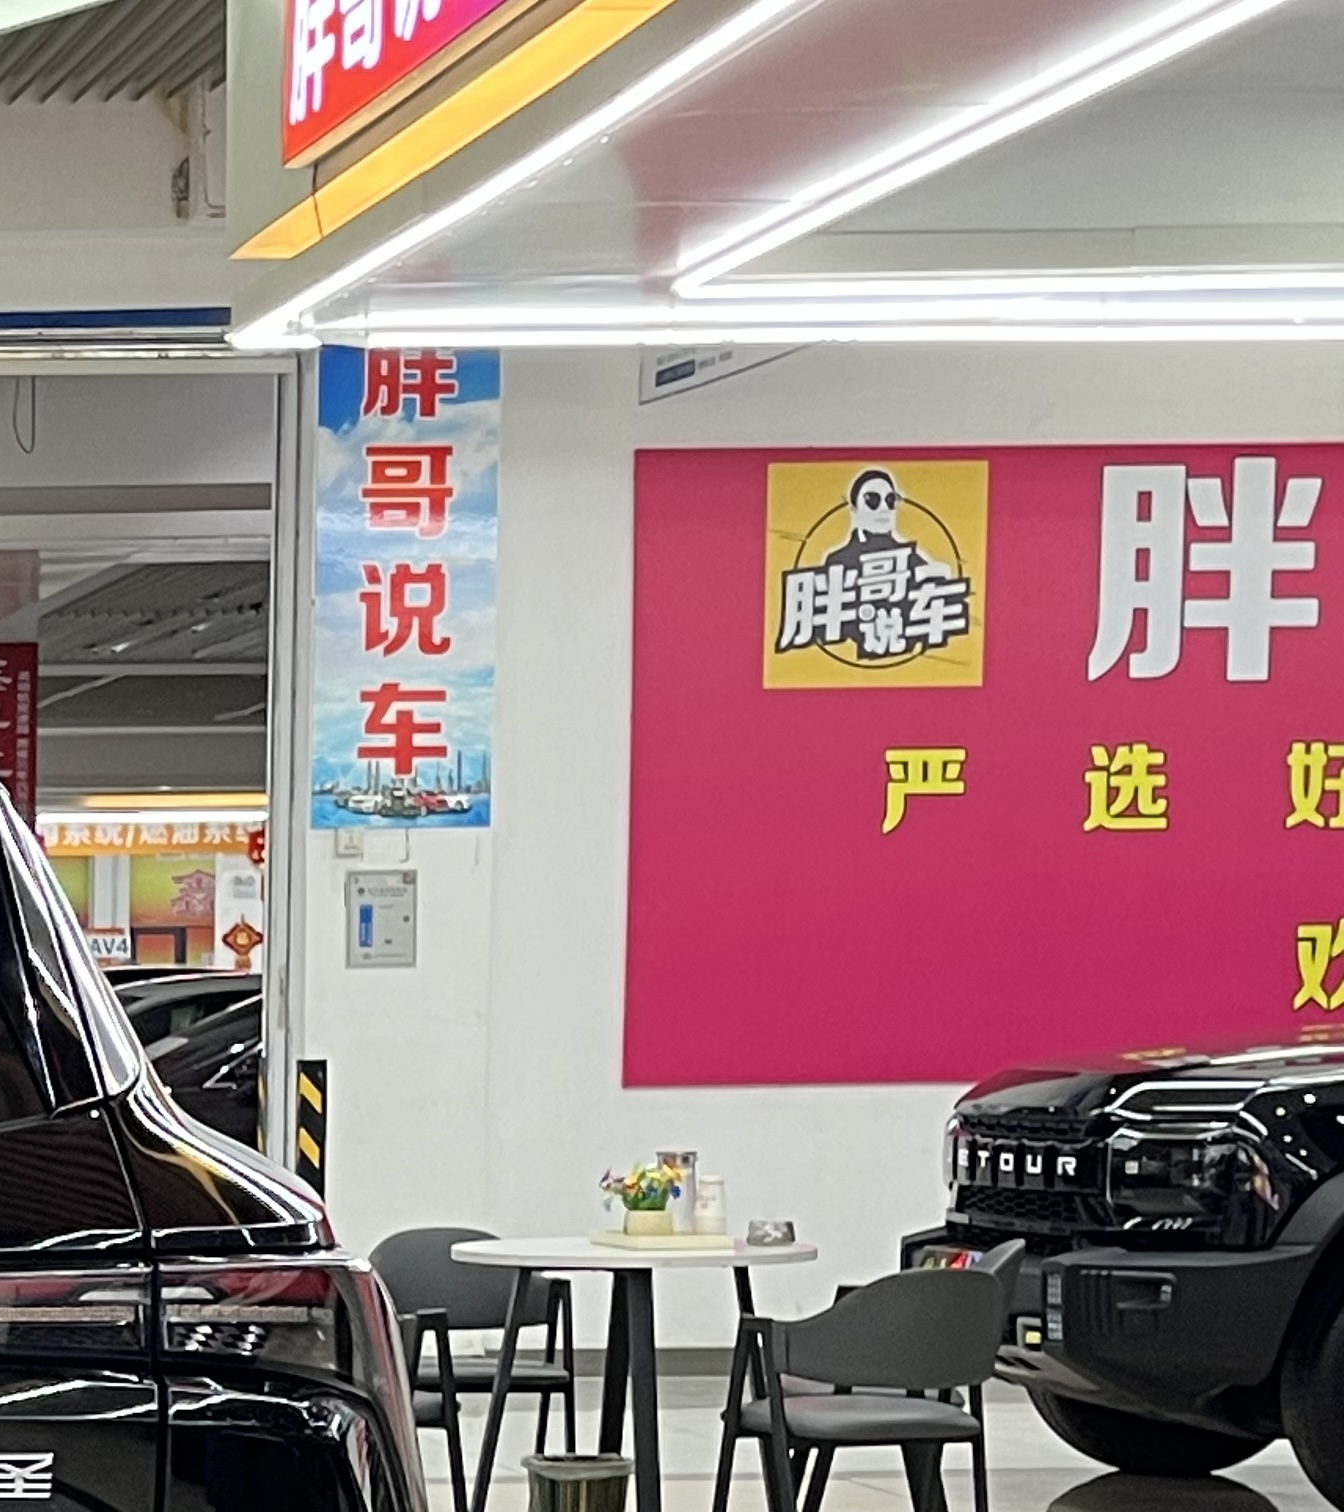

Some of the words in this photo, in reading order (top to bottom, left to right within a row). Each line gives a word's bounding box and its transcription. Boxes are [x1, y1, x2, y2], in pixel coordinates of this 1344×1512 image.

[357, 349, 459, 776] 胖哥说车
[777, 546, 968, 655] 胖哥说车
[1087, 456, 1323, 683] 胖
